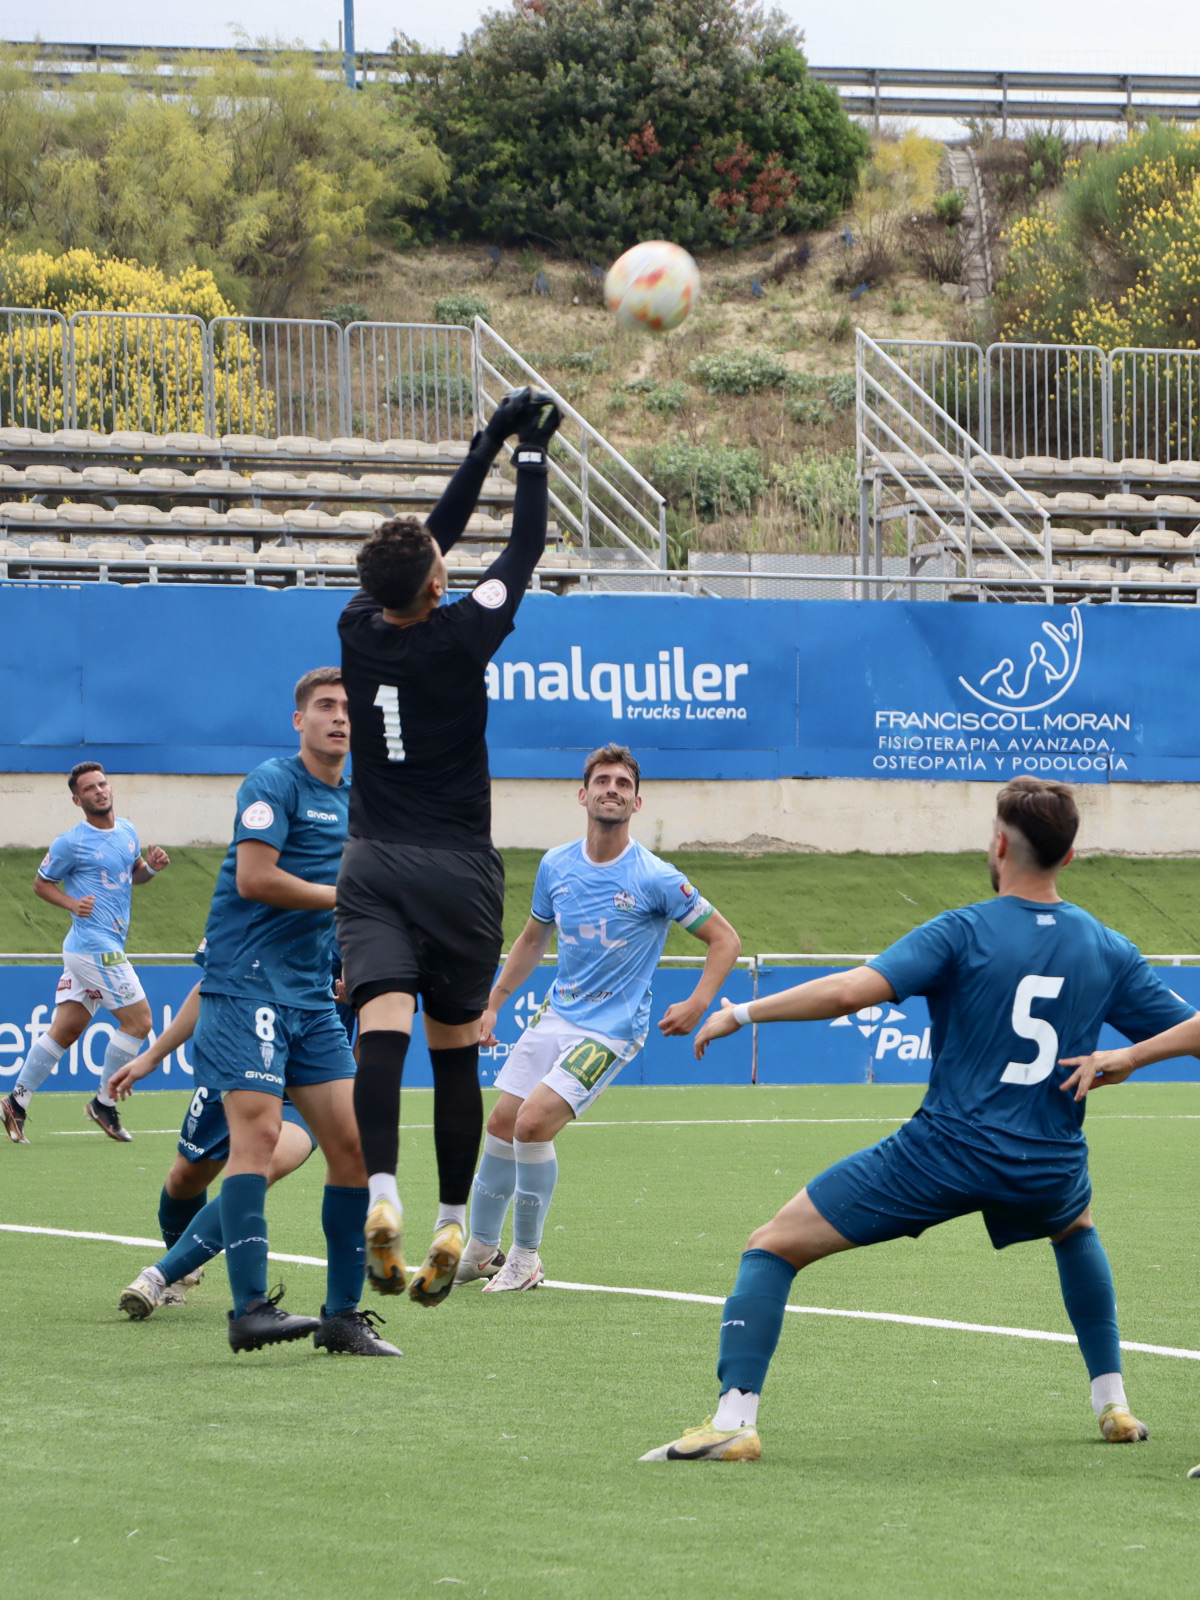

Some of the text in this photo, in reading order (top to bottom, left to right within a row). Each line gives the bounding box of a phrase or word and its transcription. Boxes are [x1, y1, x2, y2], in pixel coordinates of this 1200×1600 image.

[626, 703, 747, 719] trucks Lucena
[875, 711, 1018, 731] FRANCISCO
[373, 684, 406, 762] 1
[878, 736, 1115, 752] FISIOTERAPIA AVANZADA,
[872, 753, 1128, 771] OSTEOPATÍA Y PODOLOGÍA
[307, 810, 338, 822] GIVOVA
[255, 1007, 276, 1042] 8
[1000, 974, 1065, 1085] 5
[190, 1086, 208, 1117] 6
